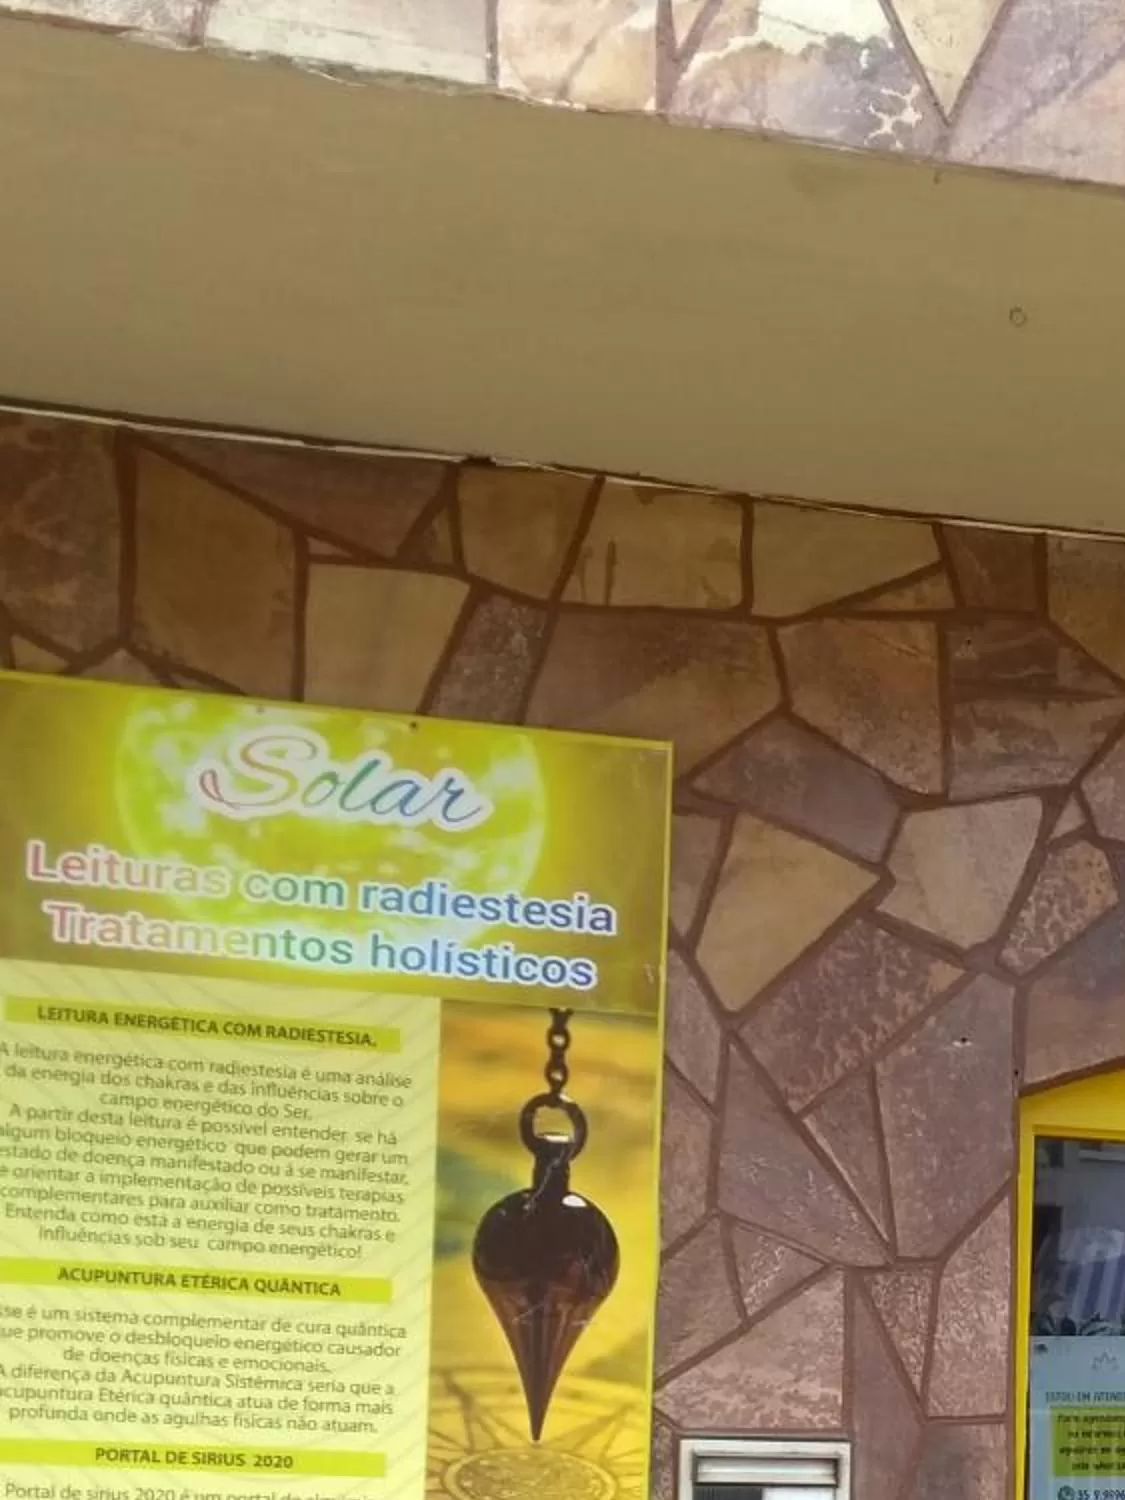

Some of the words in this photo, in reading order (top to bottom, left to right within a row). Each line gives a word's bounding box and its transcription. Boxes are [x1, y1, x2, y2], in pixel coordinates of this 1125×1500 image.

[199, 735, 483, 823] Solar
[28, 841, 229, 897] Leituras
[243, 872, 345, 909] com
[361, 880, 614, 932] radiestesia
[46, 903, 353, 965] Tratamentos
[370, 933, 596, 987] holísticos
[37, 1005, 109, 1025] LEITURA
[114, 1012, 219, 1034] ENERGÉTICA
[223, 1021, 261, 1037] COM
[58, 1267, 176, 1286] ACUPUNTURA
[181, 1272, 249, 1291] ETÉRICA
[253, 1278, 341, 1296] QUÂNTICA
[95, 1448, 161, 1463] PORTAL
[165, 1451, 187, 1465] DE
[191, 1451, 246, 1467] SIRIUS
[253, 1455, 293, 1469] 2020
